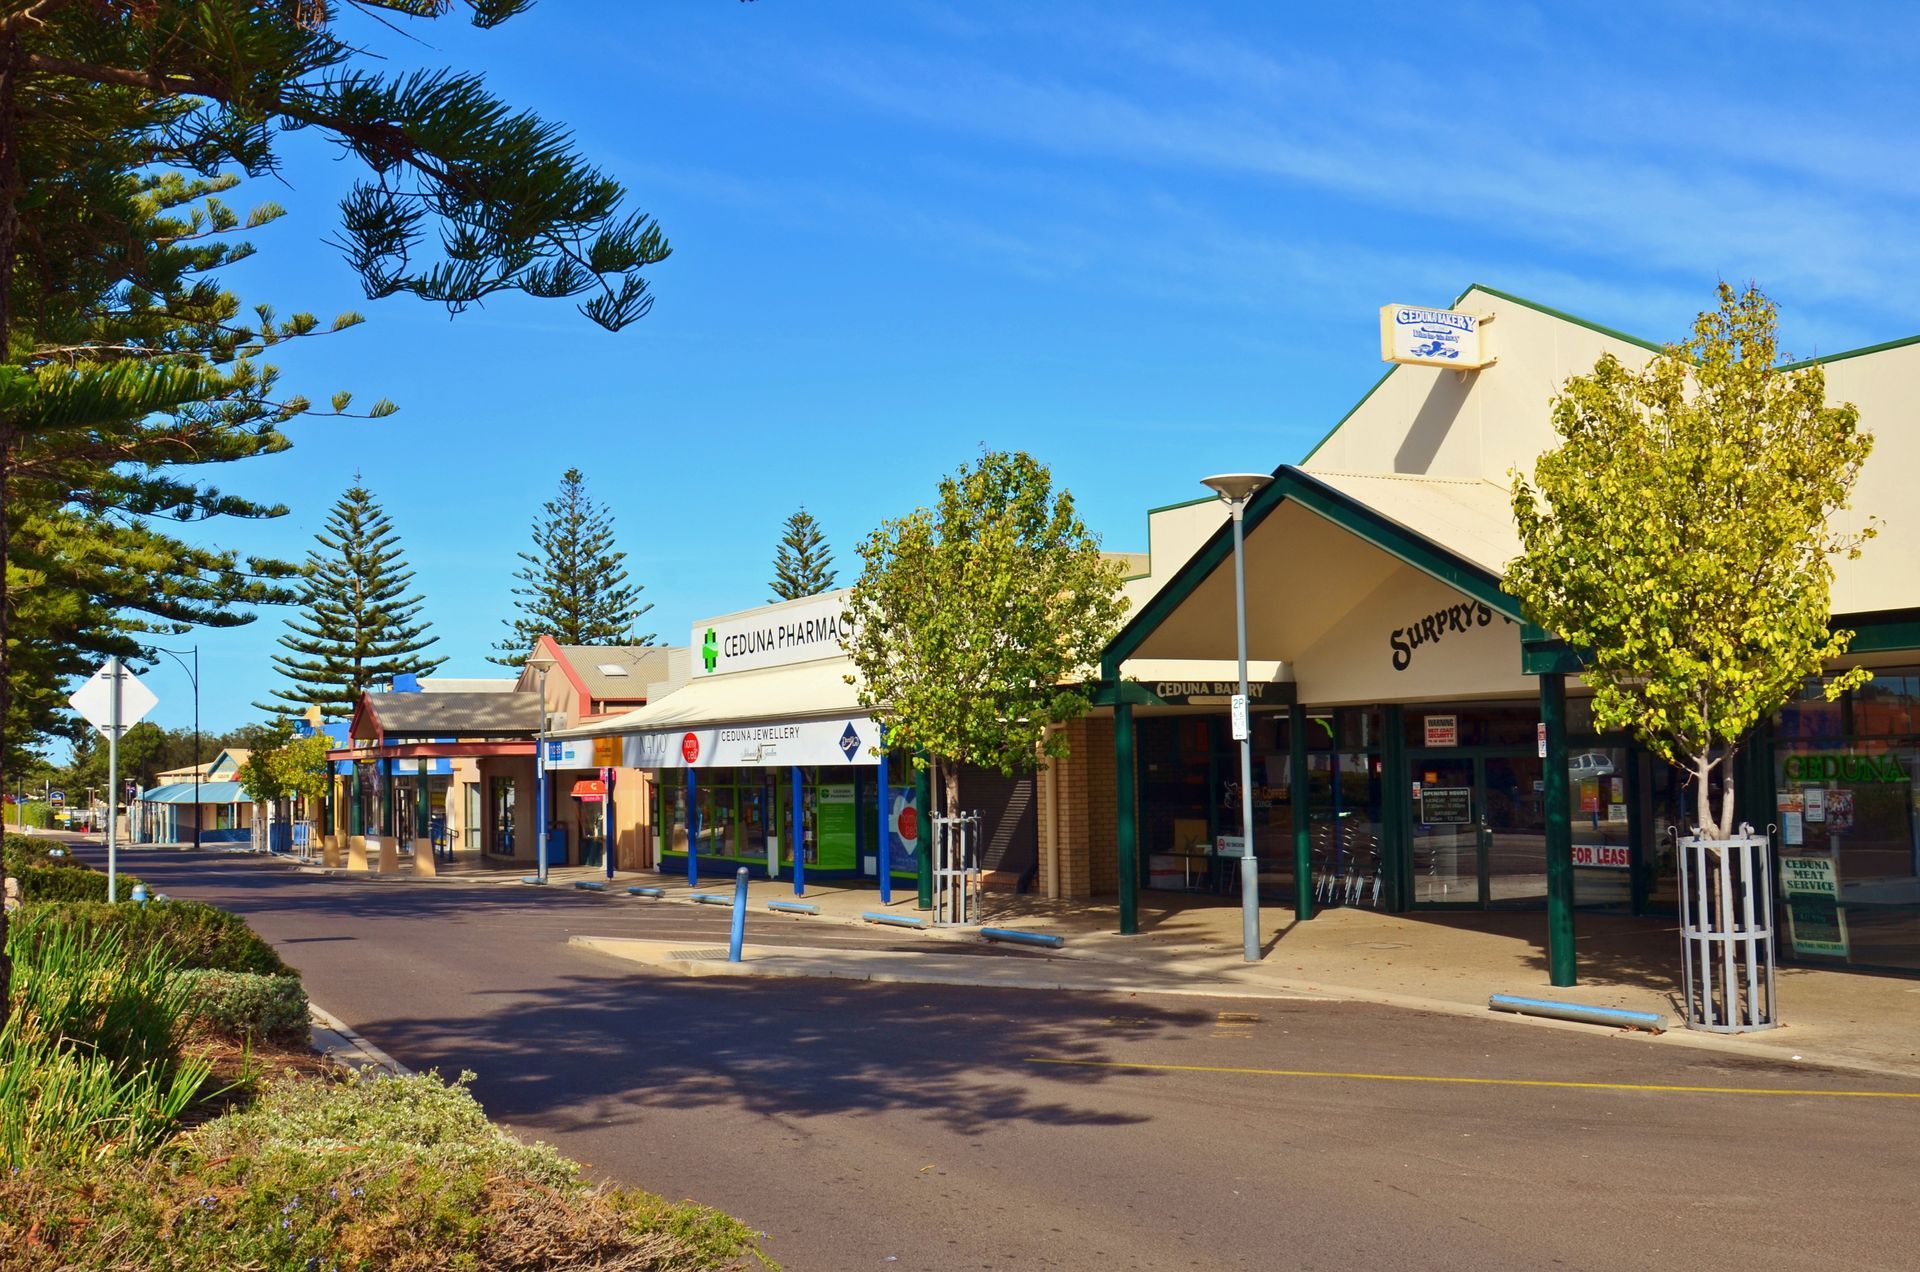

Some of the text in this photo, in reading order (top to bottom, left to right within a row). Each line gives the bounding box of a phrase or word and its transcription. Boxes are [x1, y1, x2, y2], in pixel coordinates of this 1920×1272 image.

[724, 629, 775, 658] CEDUNA
[1156, 682, 1265, 698] CEDUNA BAKRY
[1233, 698, 1245, 709] 2P
[721, 726, 800, 742] CEDUNA JEWELLERY
[1784, 754, 1910, 782] CEDUNA
[1570, 847, 1594, 864] FOR
[1785, 860, 1830, 870] CEDUNA
[1793, 870, 1825, 880] MEAT
[1786, 881, 1835, 891] SERVICE
